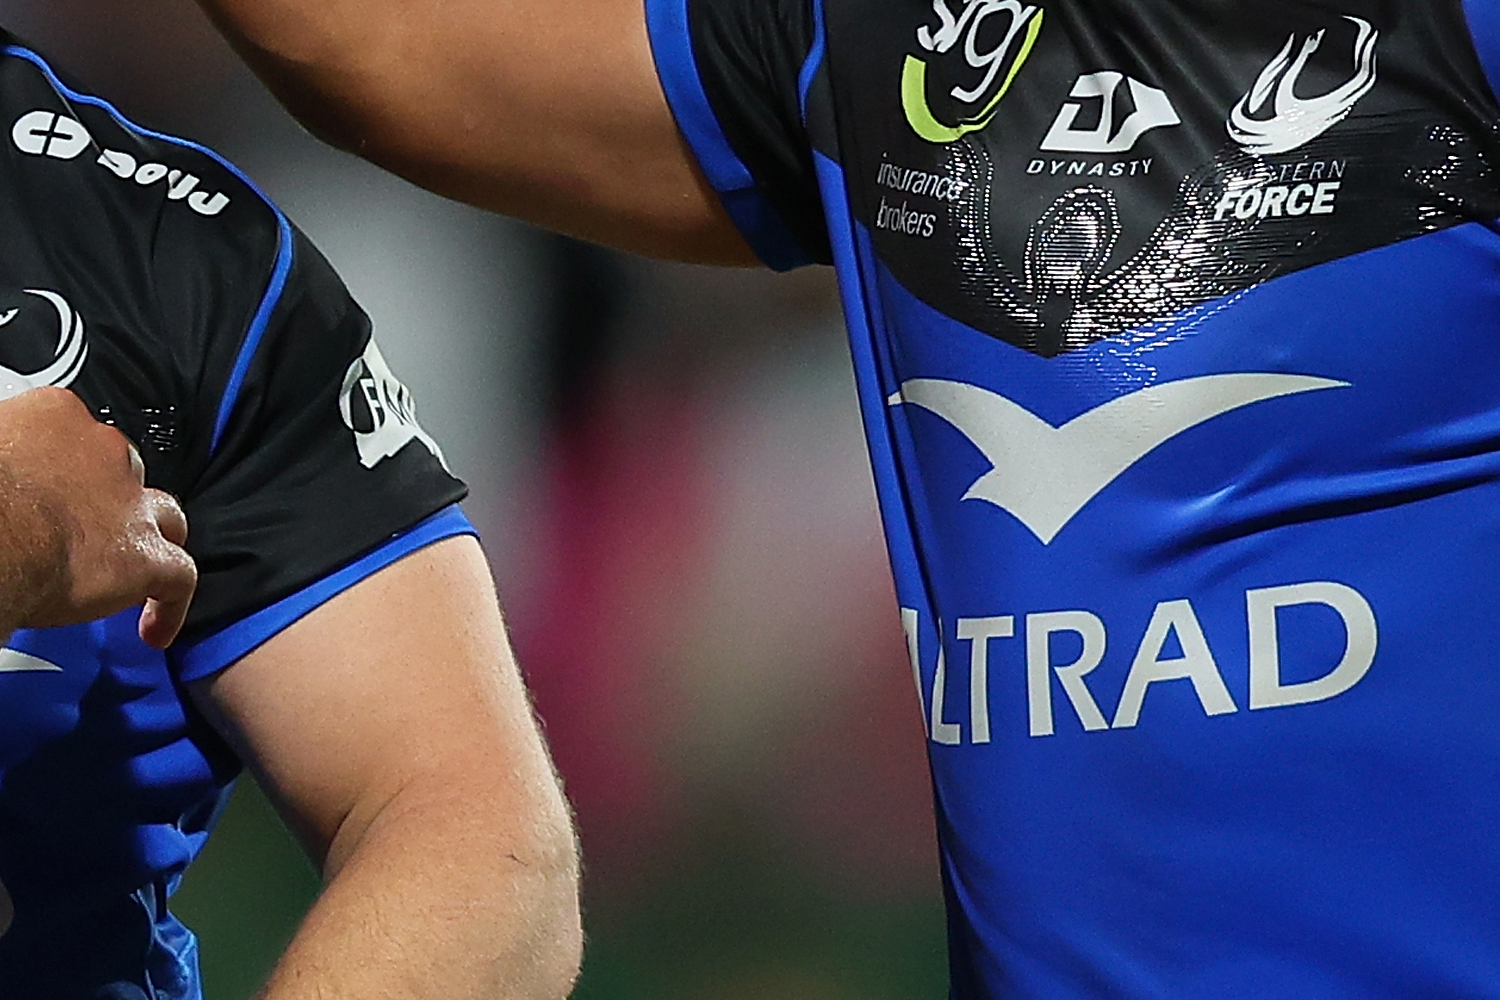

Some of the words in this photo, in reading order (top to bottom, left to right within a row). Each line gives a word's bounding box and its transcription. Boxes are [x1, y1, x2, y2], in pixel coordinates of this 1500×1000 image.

[876, 151, 961, 201] insurance
[1026, 157, 1154, 177] DYNASTY
[876, 196, 938, 238] brokers
[1213, 181, 1342, 222] FORCE
